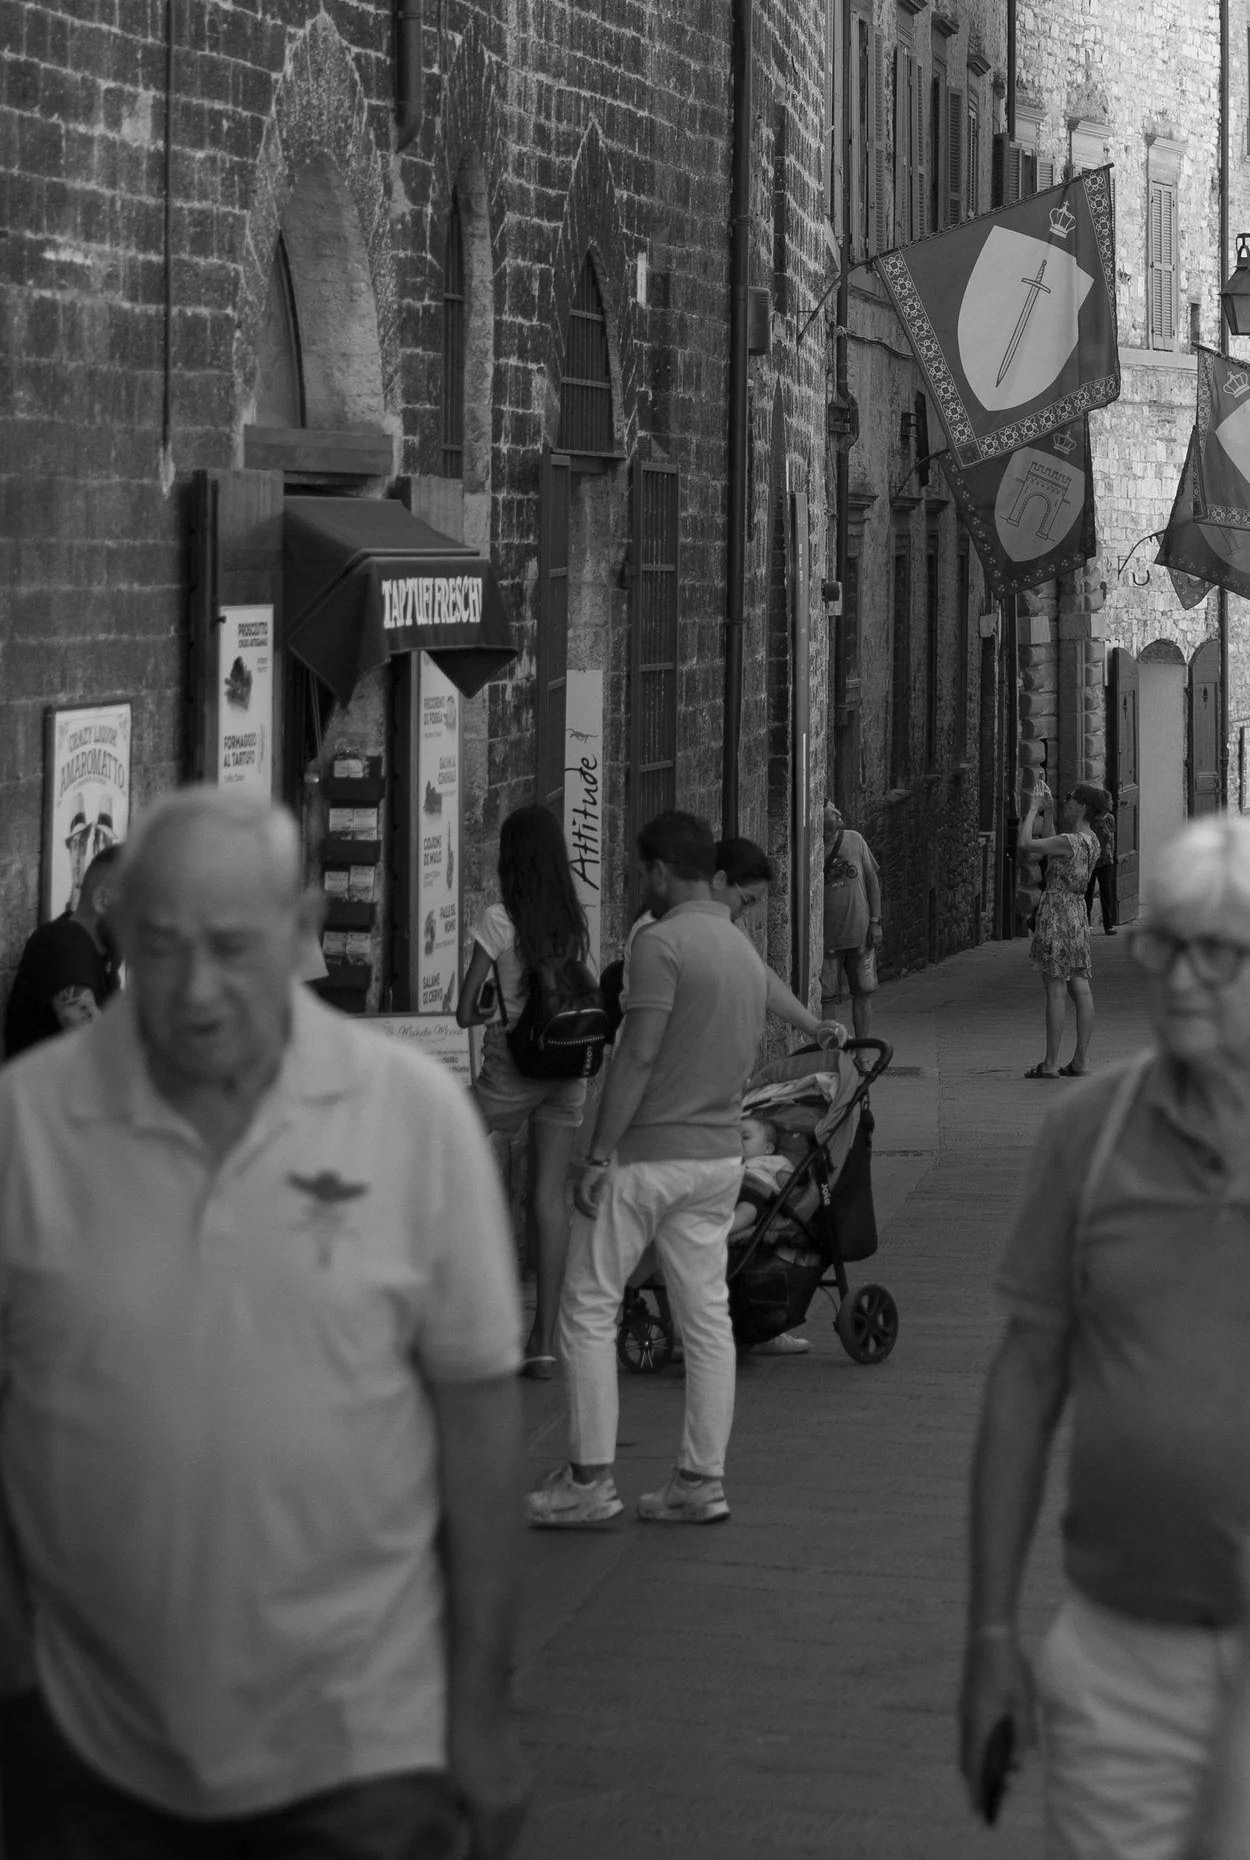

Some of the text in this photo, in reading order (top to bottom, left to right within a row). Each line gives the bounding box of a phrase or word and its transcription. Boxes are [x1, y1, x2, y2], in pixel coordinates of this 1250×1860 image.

[224, 733, 257, 750] FORMAGGIO
[60, 748, 125, 797] AMAROMATTO
[223, 750, 256, 768] AL TARTUFO
[564, 754, 600, 891] Attitude
